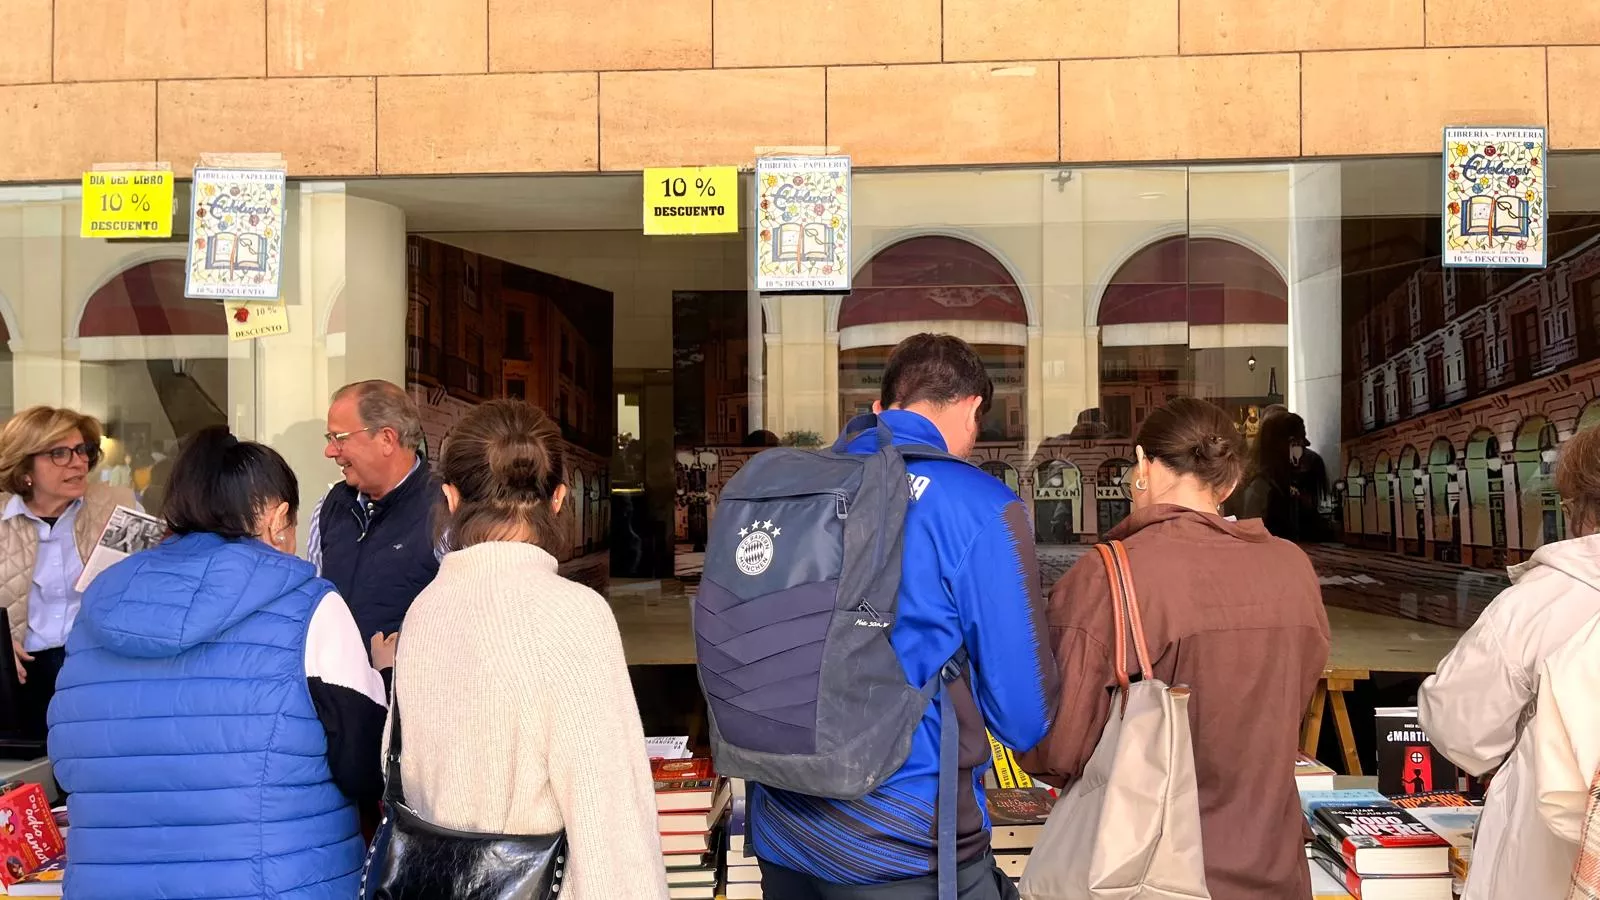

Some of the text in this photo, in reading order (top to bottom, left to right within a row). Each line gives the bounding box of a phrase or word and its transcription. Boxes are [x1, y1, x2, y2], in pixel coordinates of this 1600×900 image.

[110, 175, 128, 185] DEL
[133, 175, 163, 185] LIBRO
[660, 177, 716, 197] 10 %
[100, 193, 150, 212] 10 %
[653, 205, 725, 217] DESCUENTO
[90, 221, 158, 231] DESCUENTO
[1475, 255, 1529, 263] DESCUENTO
[216, 287, 265, 295] DESCUENTO
[256, 307, 266, 317] 10
[235, 324, 282, 338] DESCUENTO
[29, 794, 39, 813] Del
[25, 808, 44, 837] odio
[1345, 815, 1403, 825] TODO
[1338, 822, 1434, 837] MUERE
[24, 832, 50, 864] amor
